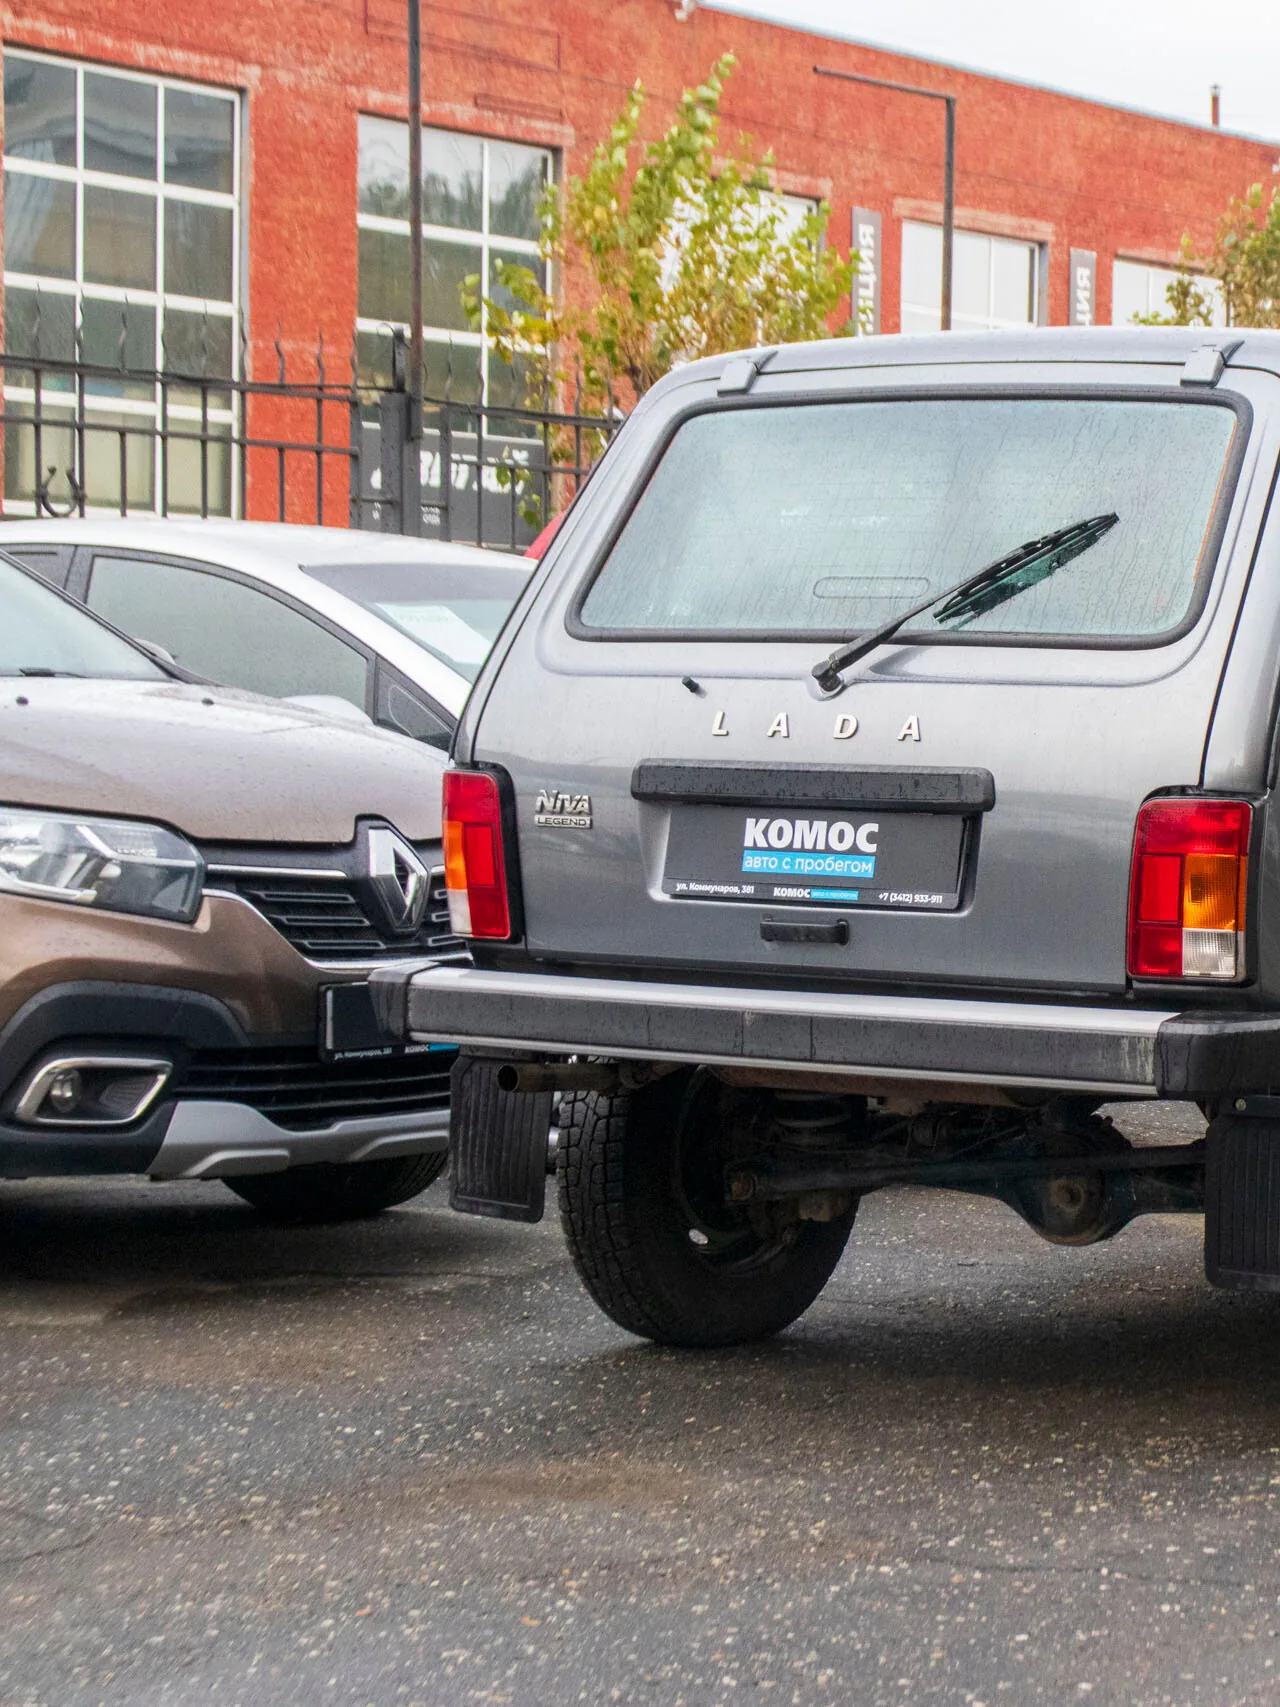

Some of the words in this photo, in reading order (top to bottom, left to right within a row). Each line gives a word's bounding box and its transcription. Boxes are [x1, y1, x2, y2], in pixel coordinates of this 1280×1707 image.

[711, 711, 921, 742] LADA
[537, 817, 587, 827] LEGEND
[743, 817, 879, 852] КОМОС
[744, 856, 779, 870] авто
[781, 858, 792, 870] с
[795, 856, 873, 874] пробегом
[676, 883, 688, 892] ул.
[878, 893, 889, 901] +7
